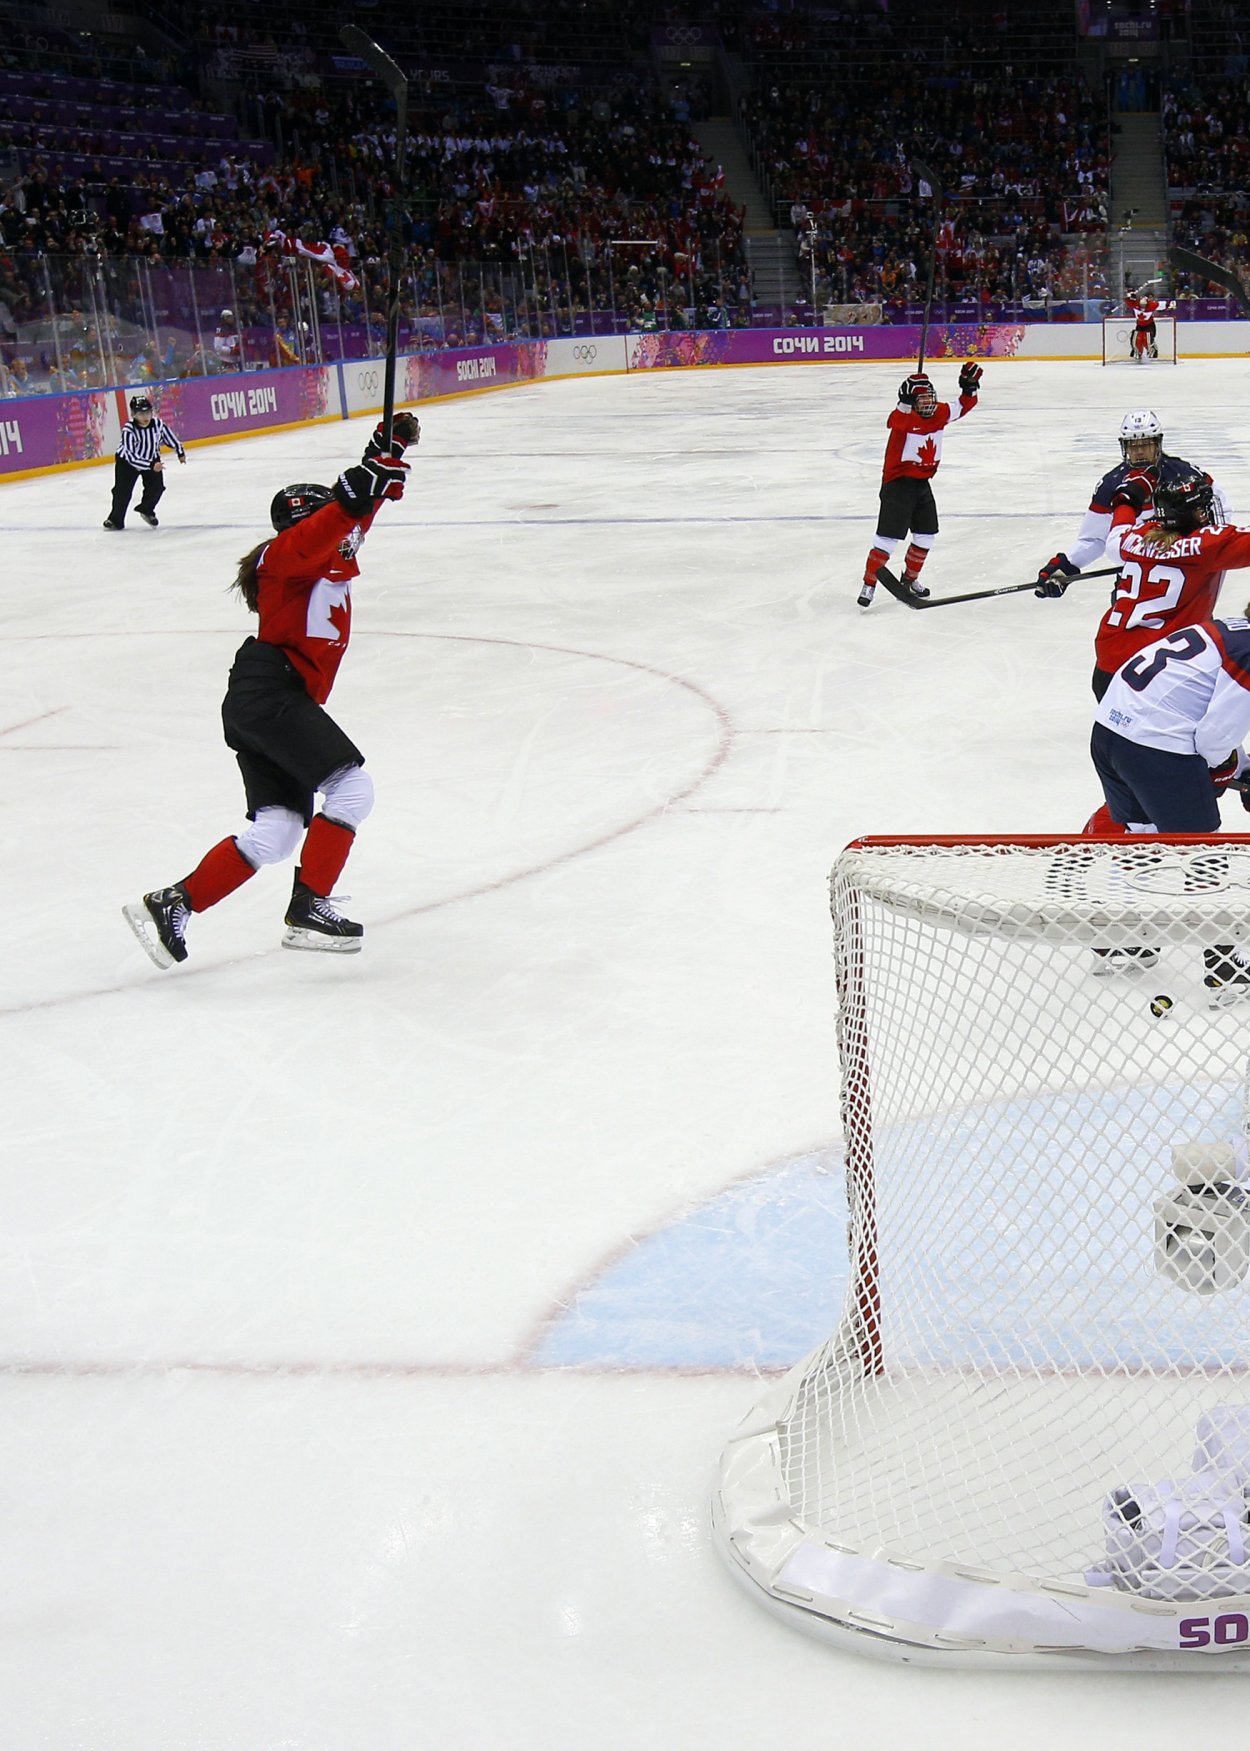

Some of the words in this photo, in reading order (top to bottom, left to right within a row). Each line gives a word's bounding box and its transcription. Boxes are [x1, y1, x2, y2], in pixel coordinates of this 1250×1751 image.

[773, 337, 820, 354] СОЧИ
[824, 336, 864, 352] 2014
[456, 359, 479, 381] SOCHI
[479, 357, 497, 378] 2014
[210, 391, 248, 421] СОЧИ
[248, 387, 278, 416] 2014
[1107, 561, 1187, 630] 22
